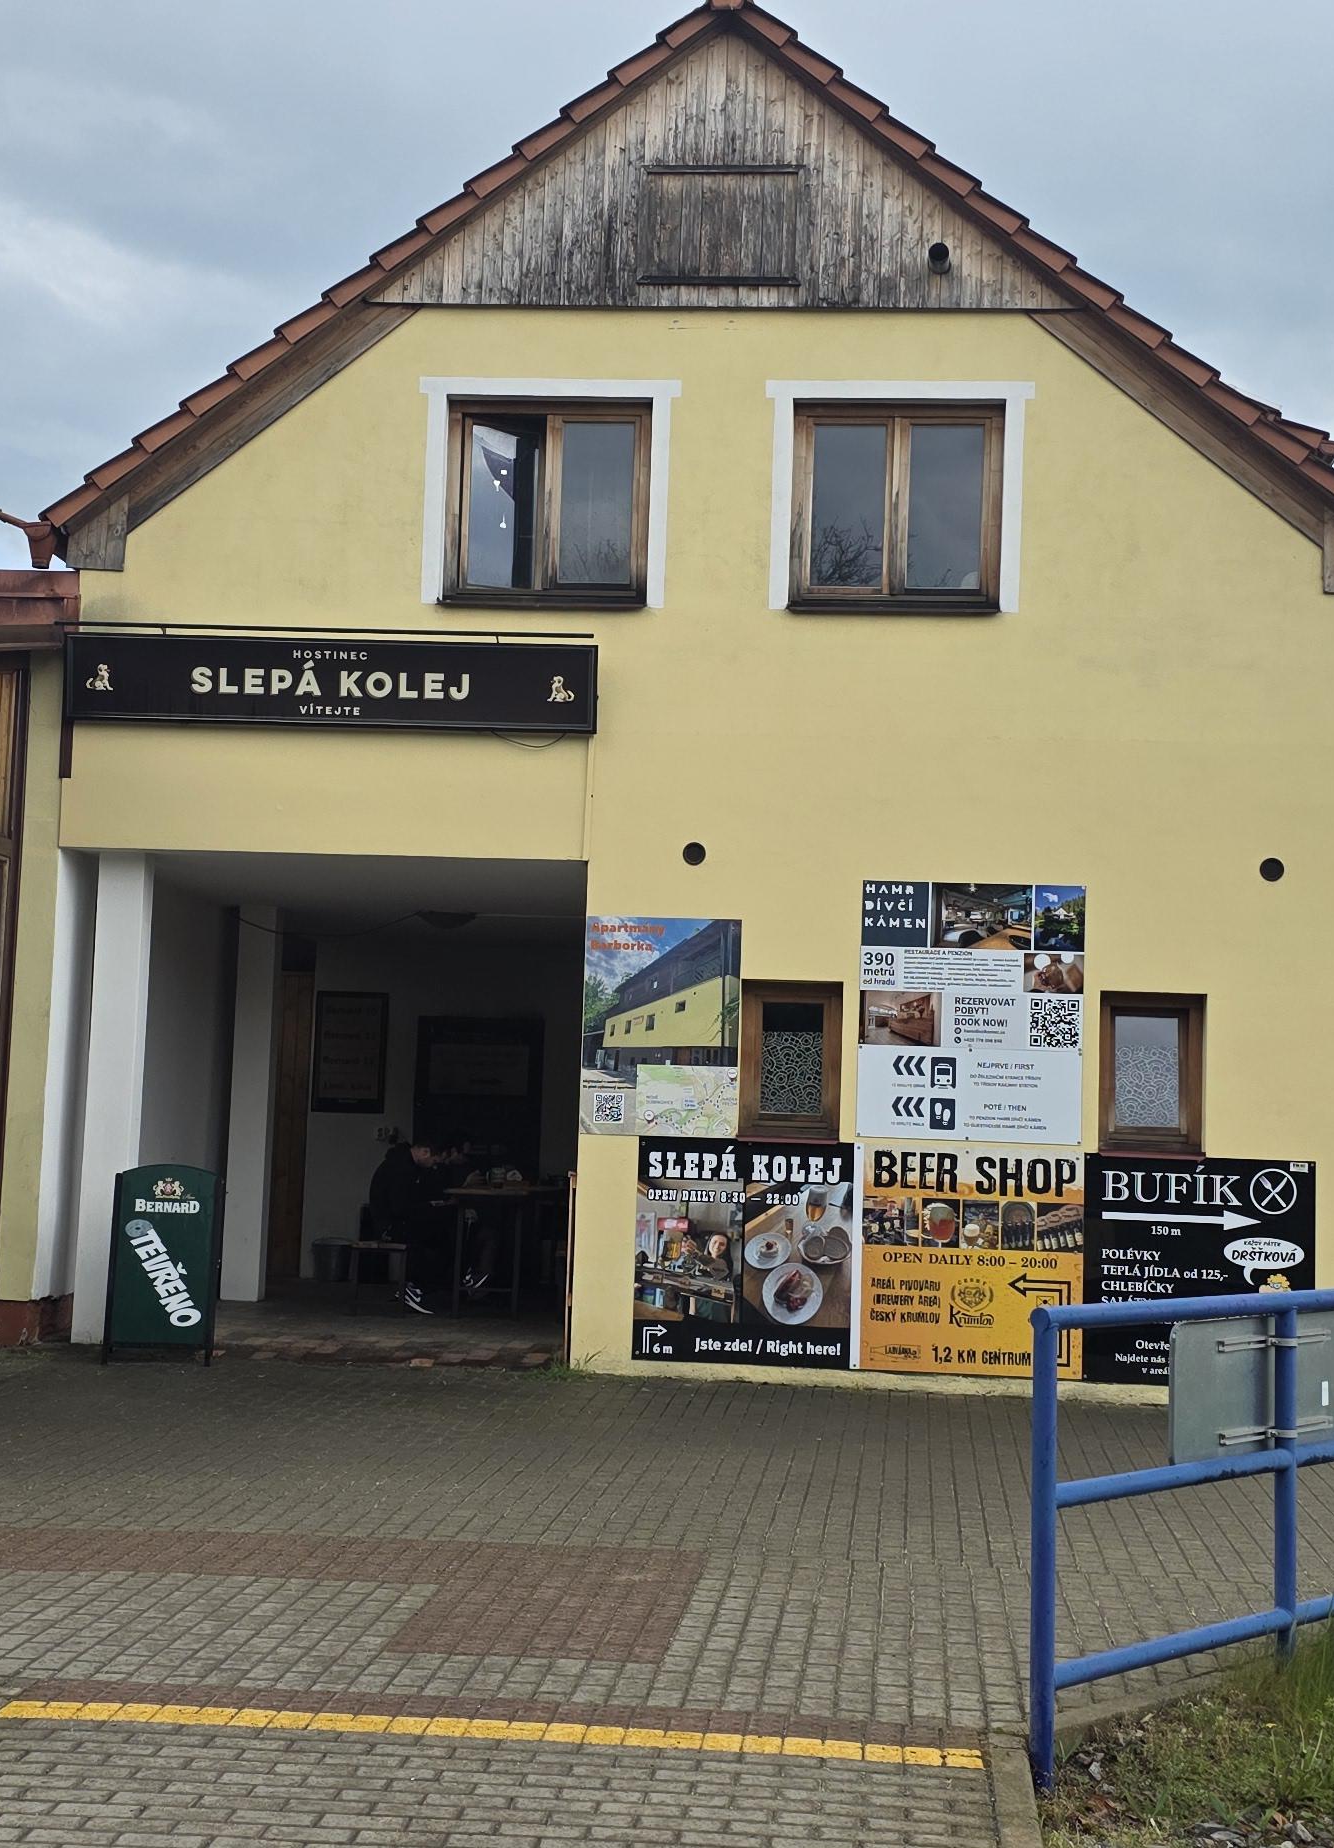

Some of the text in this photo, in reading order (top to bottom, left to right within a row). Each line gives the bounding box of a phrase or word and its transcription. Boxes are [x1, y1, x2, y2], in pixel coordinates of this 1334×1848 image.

[292, 649, 369, 661] HOSTINEC
[190, 661, 471, 701] SLEPÁ KOLEJ
[298, 703, 361, 716] VÍTEJTE
[865, 883, 914, 895] HAMR
[864, 898, 913, 912] DÍVČÍ
[864, 914, 926, 929] KÁMEN
[590, 922, 666, 937] Apartmány
[863, 951, 895, 966] 390
[863, 966, 895, 977] metrů
[862, 977, 896, 986] od hradu
[954, 996, 1017, 1007] REZERVOVAT
[954, 1007, 989, 1015] POBYT!
[954, 1017, 1008, 1028] BOOK NOW!
[977, 1062, 1009, 1070] NEJPRVE
[983, 1103, 1002, 1111] POTÉ
[648, 1145, 842, 1184] SLEPÁ KOLEJ
[873, 1150, 1077, 1198] BEER SHOP
[1101, 1165, 1243, 1207] BUFÍK
[647, 1188, 677, 1202] OPEN
[681, 1189, 716, 1203] DAILY
[765, 1192, 800, 1206] 22:00
[134, 1198, 200, 1214] BERNARD
[1151, 1226, 1181, 1236] 150 m
[882, 1251, 923, 1264] OPEN
[929, 1253, 973, 1266] DAILY
[977, 1255, 1005, 1268] 8:00
[1021, 1256, 1058, 1270] 20:00
[1101, 1247, 1161, 1261] POLÉVKY
[1231, 1247, 1298, 1263] DRŠŤKOVÁ
[1101, 1263, 1228, 1282] TEPLÁ JÍDLA od 125,-
[870, 1275, 941, 1292] AREÁL PIVOVARU
[1101, 1279, 1175, 1294] CHLEBÍČKY
[872, 1292, 941, 1309] (BREWERY AREA)
[869, 1307, 941, 1325] ČESKÝ KRUMLOV
[948, 1304, 995, 1328] Krumlov
[652, 1342, 673, 1354] 6 m
[694, 1337, 721, 1353] Jste
[723, 1339, 753, 1353] zde!
[766, 1340, 804, 1356] Right
[806, 1341, 842, 1356] here!
[932, 1346, 1031, 1367] 1,2 KM CENTRUM
[1115, 1352, 1166, 1364] Najdete nás
